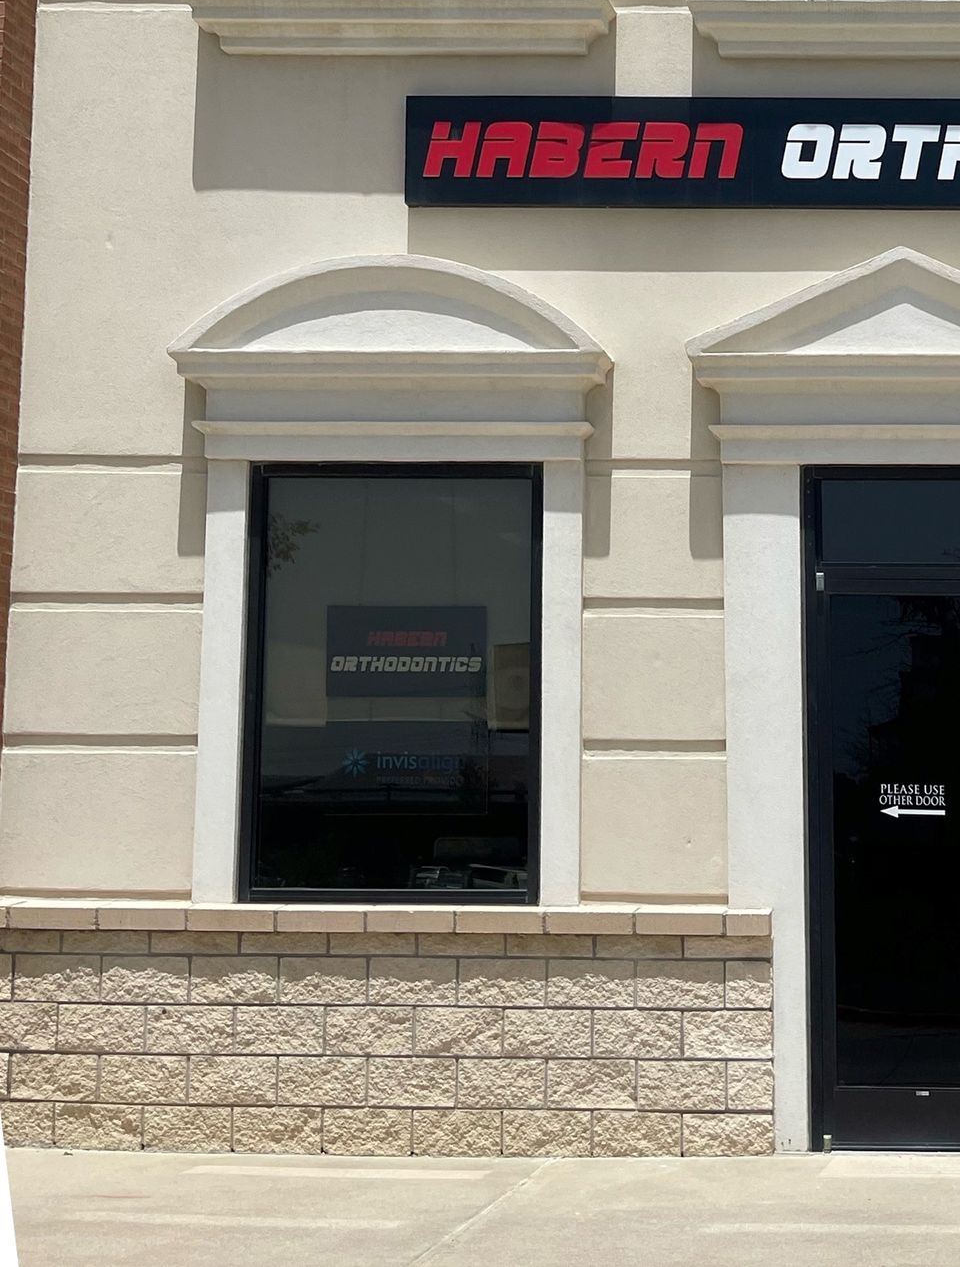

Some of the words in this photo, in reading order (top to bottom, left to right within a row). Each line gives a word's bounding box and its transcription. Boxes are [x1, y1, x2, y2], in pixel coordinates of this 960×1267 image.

[422, 121, 745, 179] HABERN
[330, 655, 482, 673] ORTHODONTICS
[880, 783, 920, 795] PLEASE
[923, 784, 945, 796] USE
[879, 794, 914, 805] OTHER
[915, 795, 946, 806] DOOR
